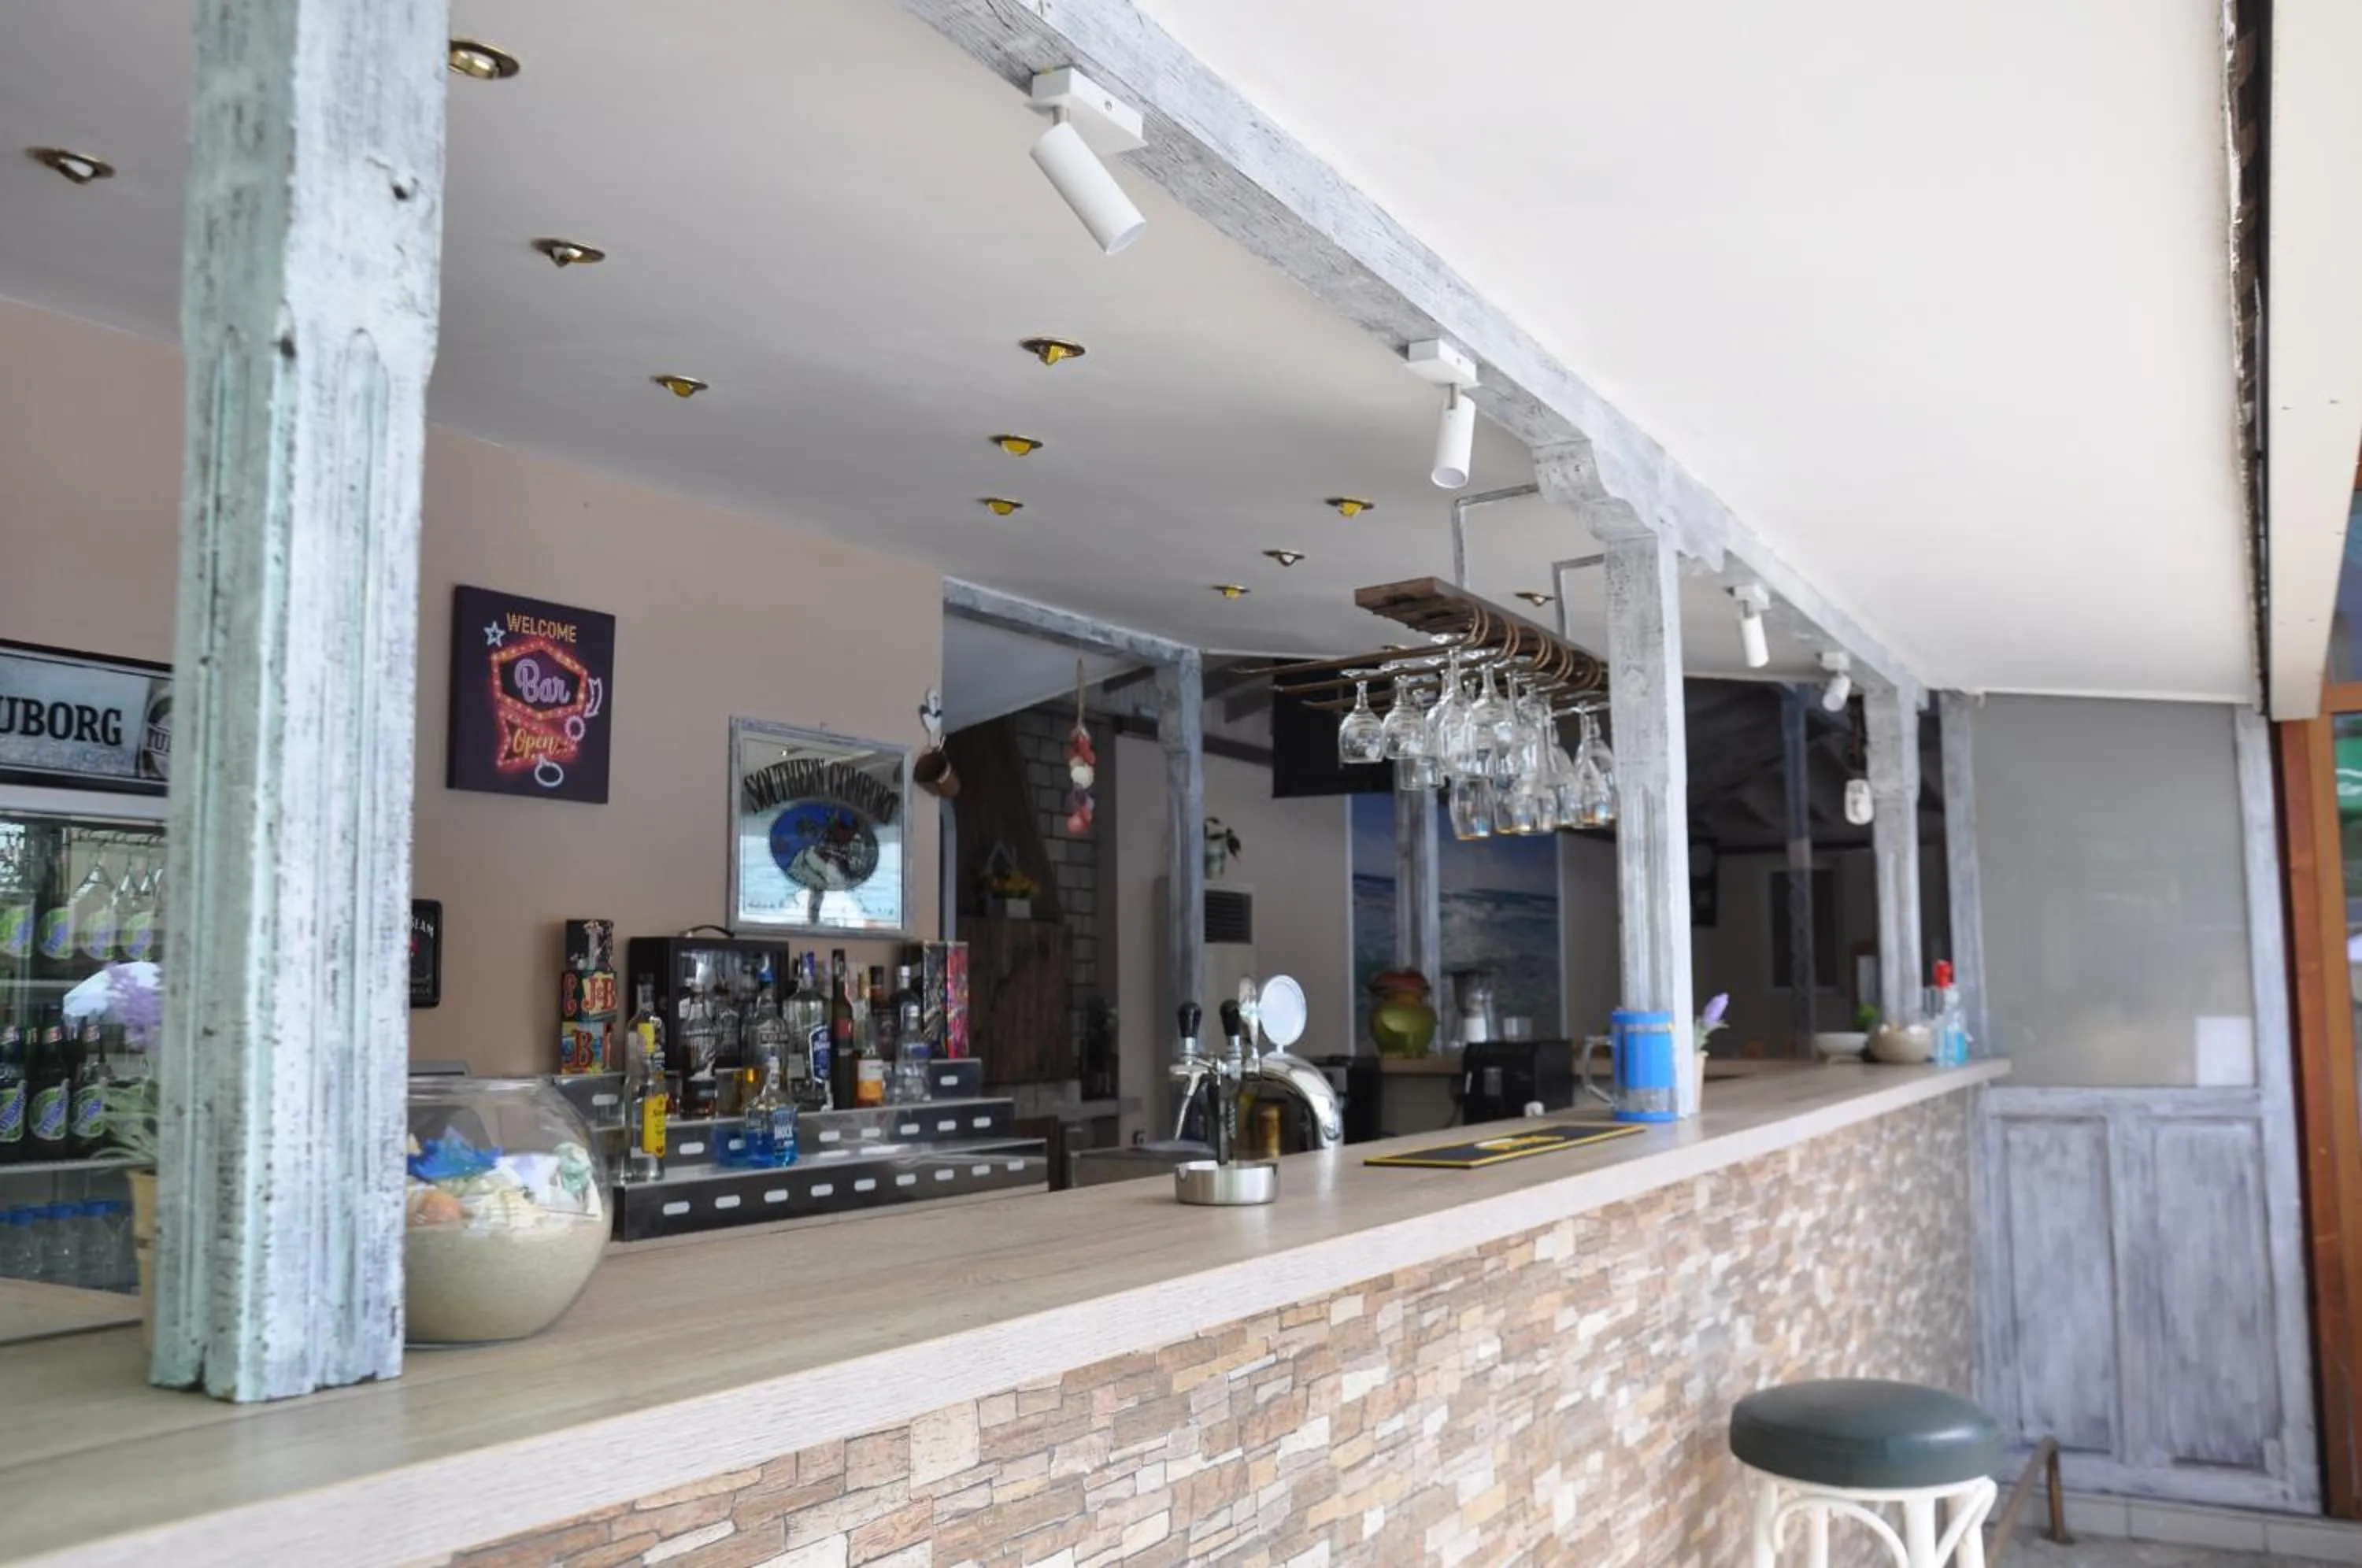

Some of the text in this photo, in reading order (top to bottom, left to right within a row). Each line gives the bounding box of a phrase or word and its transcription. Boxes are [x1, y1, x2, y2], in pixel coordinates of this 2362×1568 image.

[506, 612, 577, 643] WELCOME
[514, 659, 570, 704] Bar
[0, 695, 122, 746] UBORG
[513, 728, 558, 759] Open
